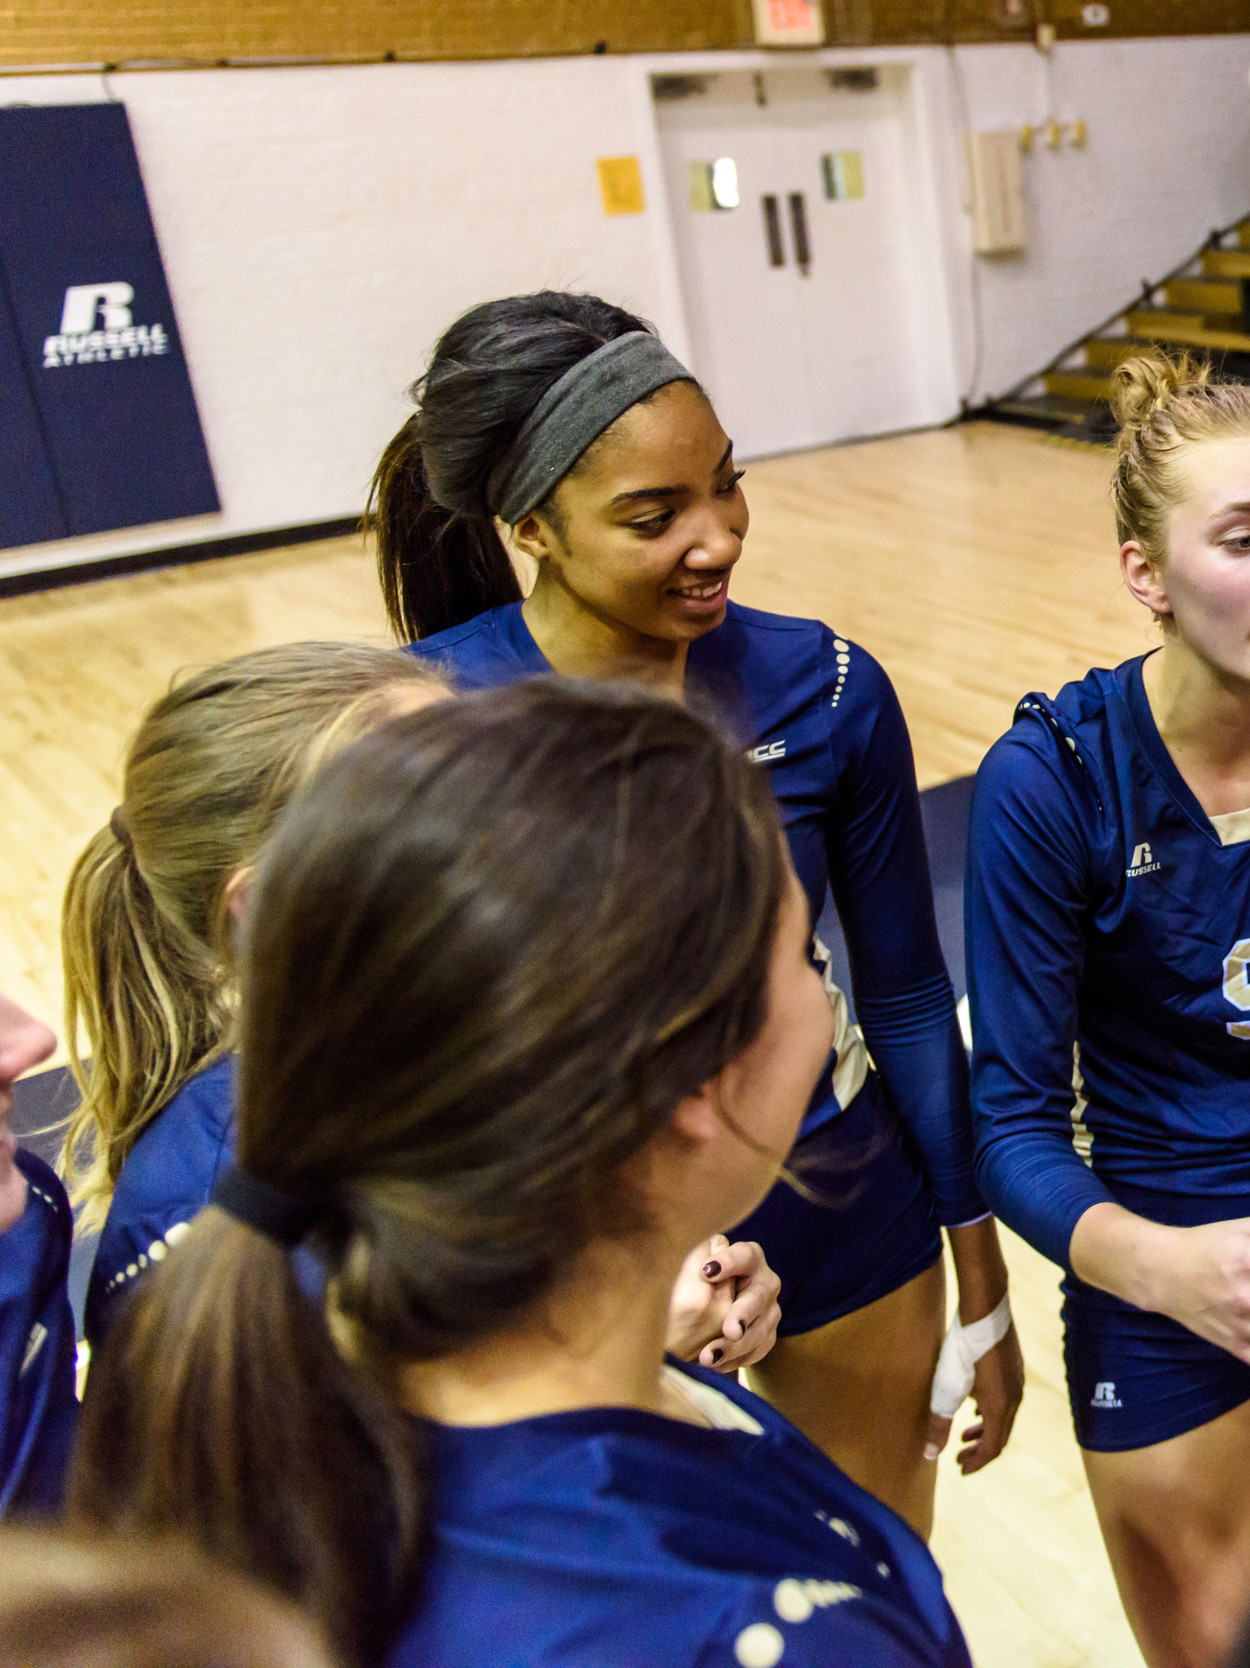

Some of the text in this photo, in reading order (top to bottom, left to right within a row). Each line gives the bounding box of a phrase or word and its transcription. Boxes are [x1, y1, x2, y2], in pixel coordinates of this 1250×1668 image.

[60, 281, 134, 335] R
[43, 323, 168, 357] RUSSELL
[43, 344, 169, 369] ATHLETIC
[1130, 842, 1152, 868] R
